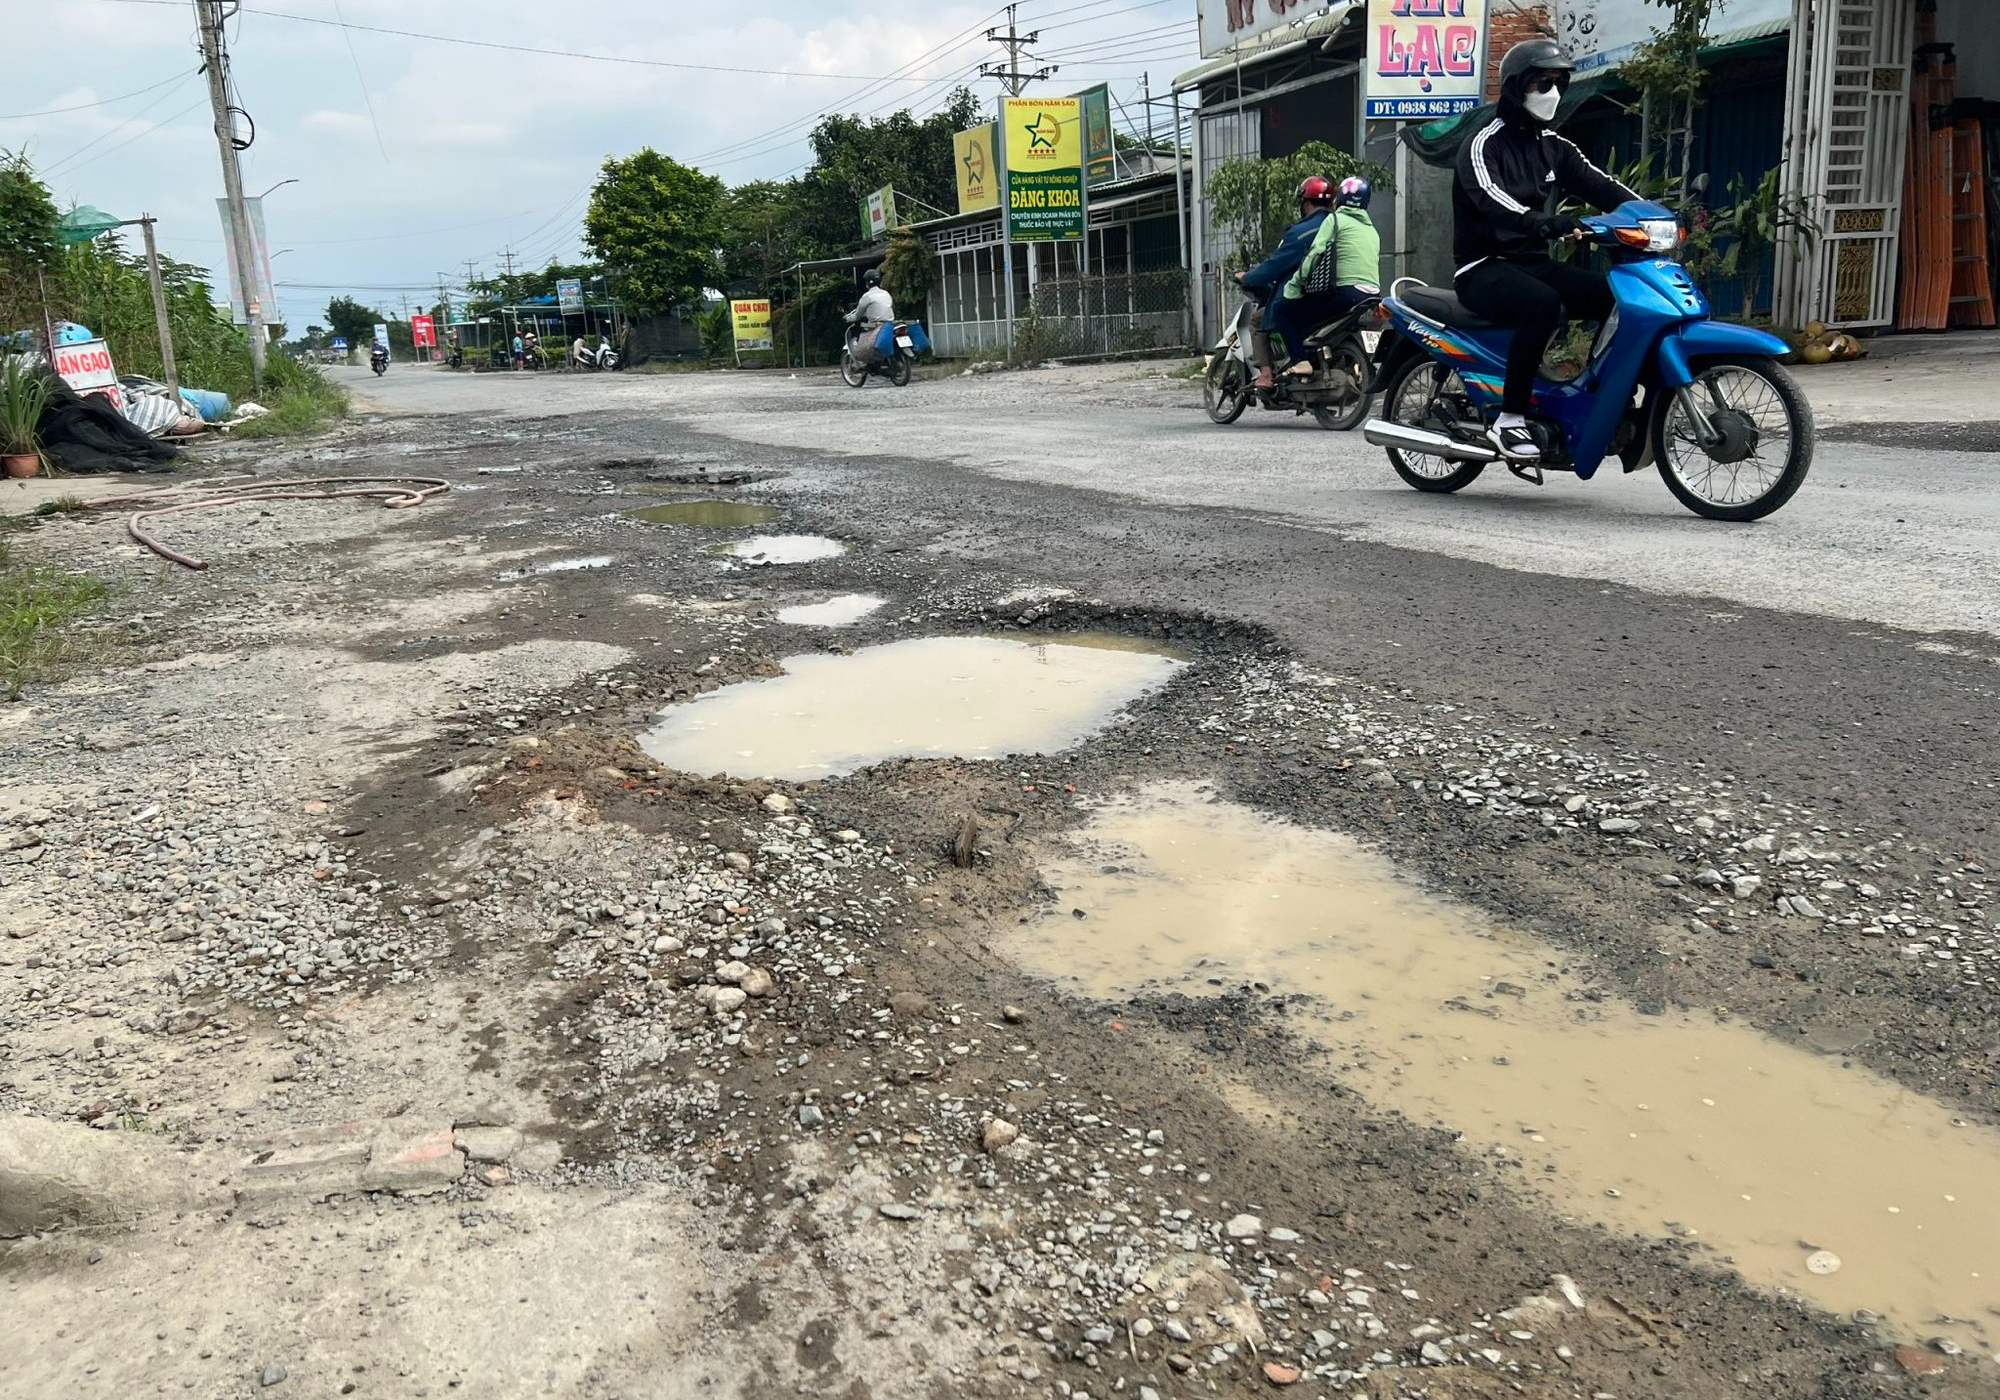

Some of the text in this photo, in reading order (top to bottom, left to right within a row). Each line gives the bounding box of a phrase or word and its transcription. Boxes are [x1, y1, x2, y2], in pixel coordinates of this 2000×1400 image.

[1376, 24, 1477, 93] LẠC
[1397, 101, 1427, 115] 0938
[1428, 101, 1450, 113] 862
[1010, 186, 1080, 208] ĐĂNG KHOA
[1407, 320, 1442, 341] Wave
